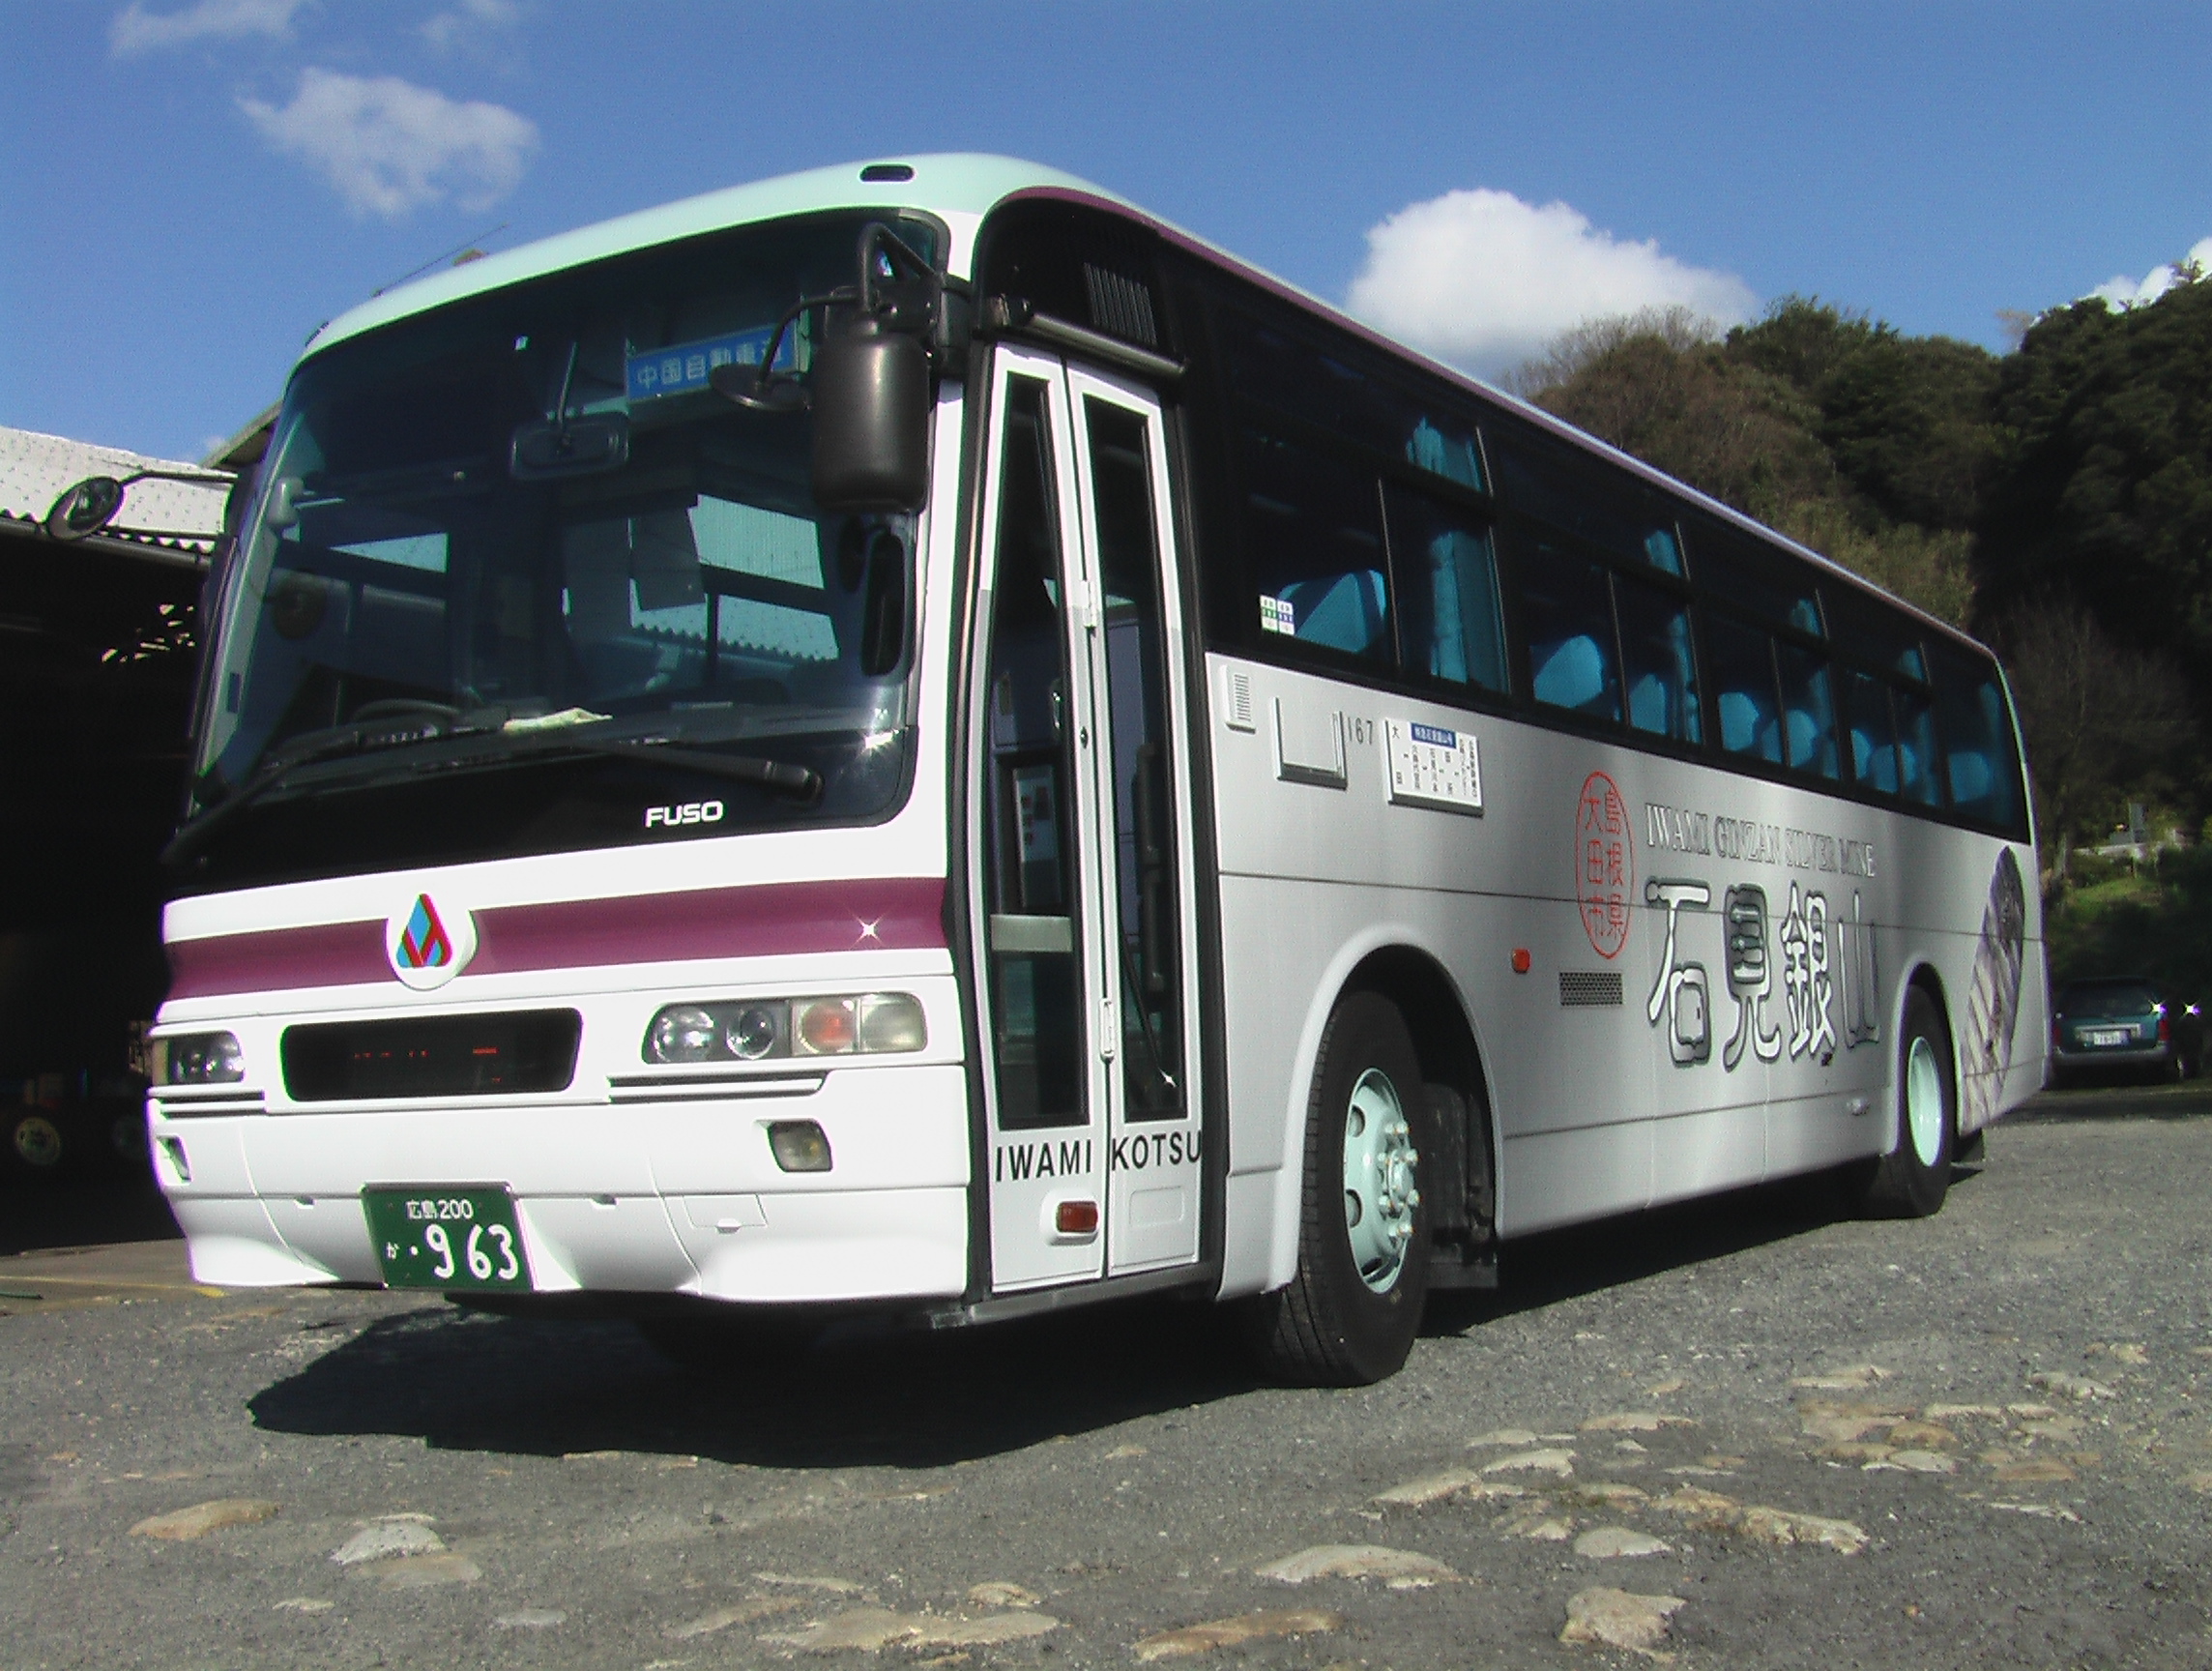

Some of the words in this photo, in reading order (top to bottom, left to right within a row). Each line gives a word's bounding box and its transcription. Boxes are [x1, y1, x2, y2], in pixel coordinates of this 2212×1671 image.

[1348, 718, 1374, 745] 167
[645, 801, 723, 828] FUSO
[1645, 803, 1710, 856] IWAMI
[1714, 816, 1781, 865] GINZAN
[1644, 875, 1879, 1072] 石見銀山
[996, 1139, 1091, 1182] IWAMI
[1112, 1129, 1202, 1172] KOTSU
